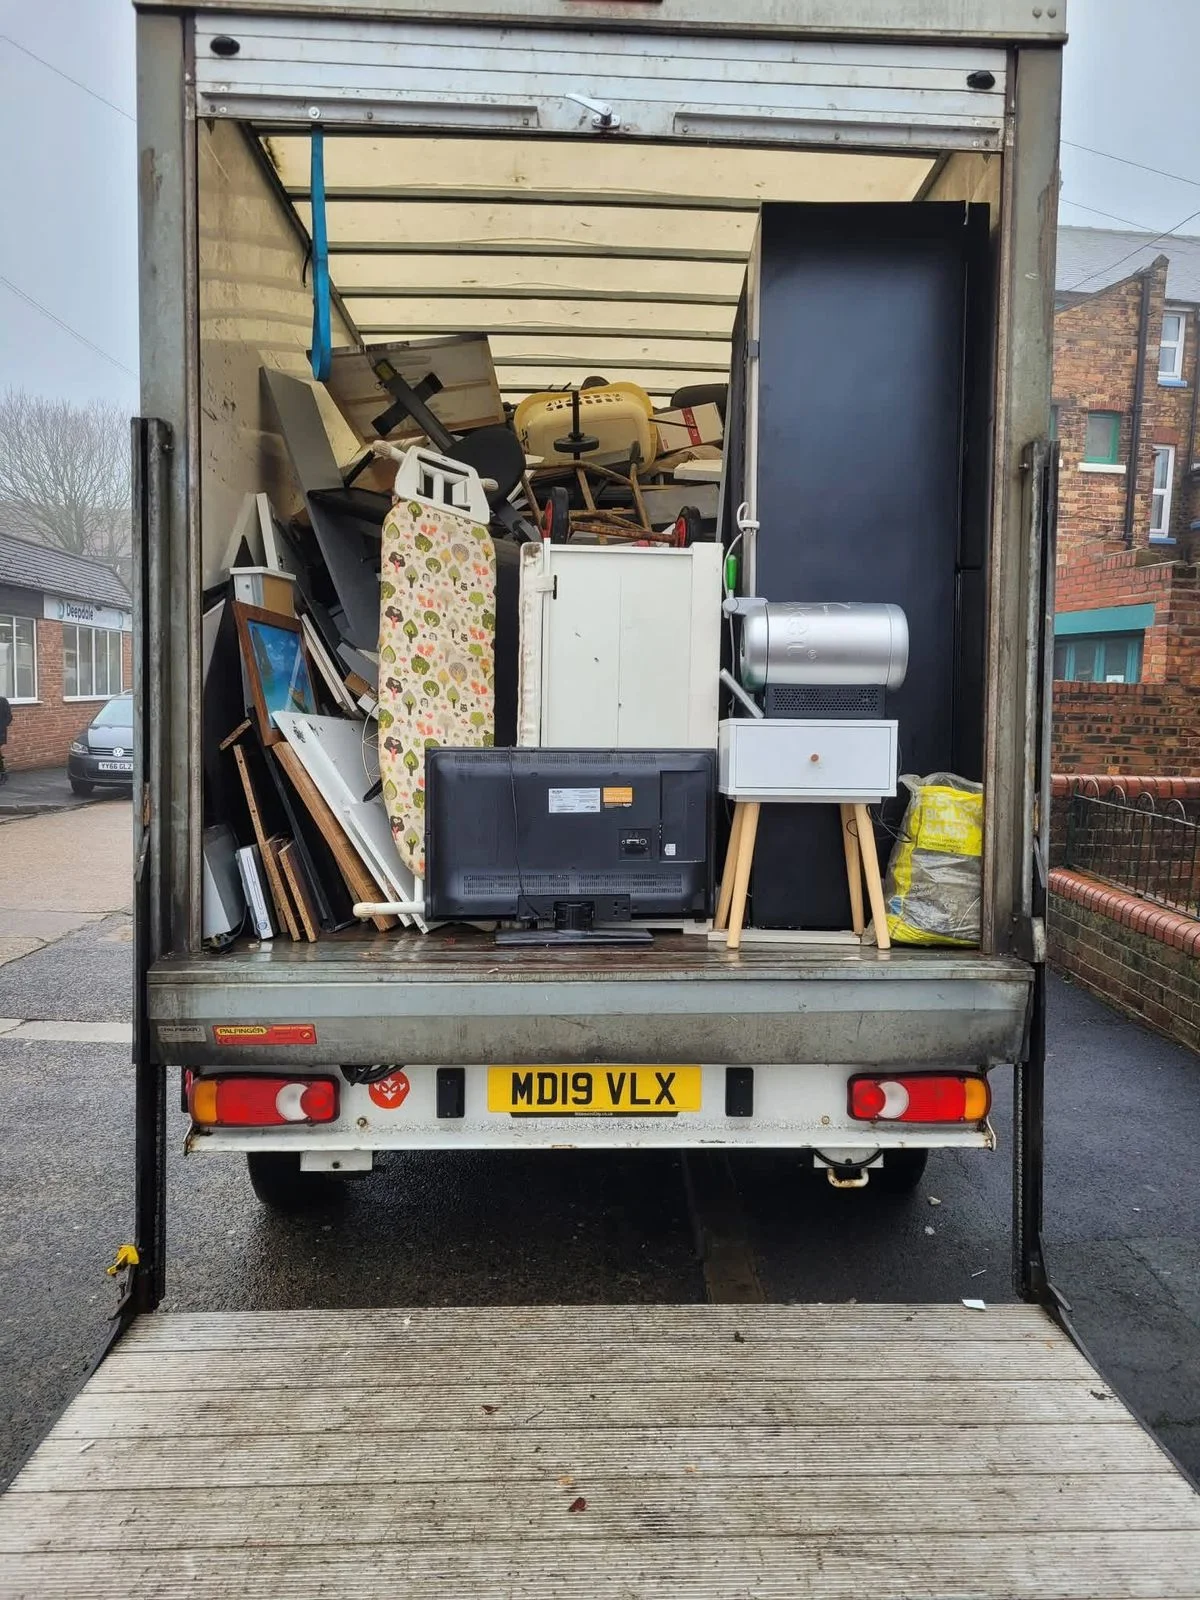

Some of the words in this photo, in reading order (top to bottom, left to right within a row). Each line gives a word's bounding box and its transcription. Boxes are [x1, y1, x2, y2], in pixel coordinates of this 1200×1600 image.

[66, 602, 94, 621] Deepdale
[511, 1072, 593, 1105] MD19
[606, 1072, 676, 1105] VLX
